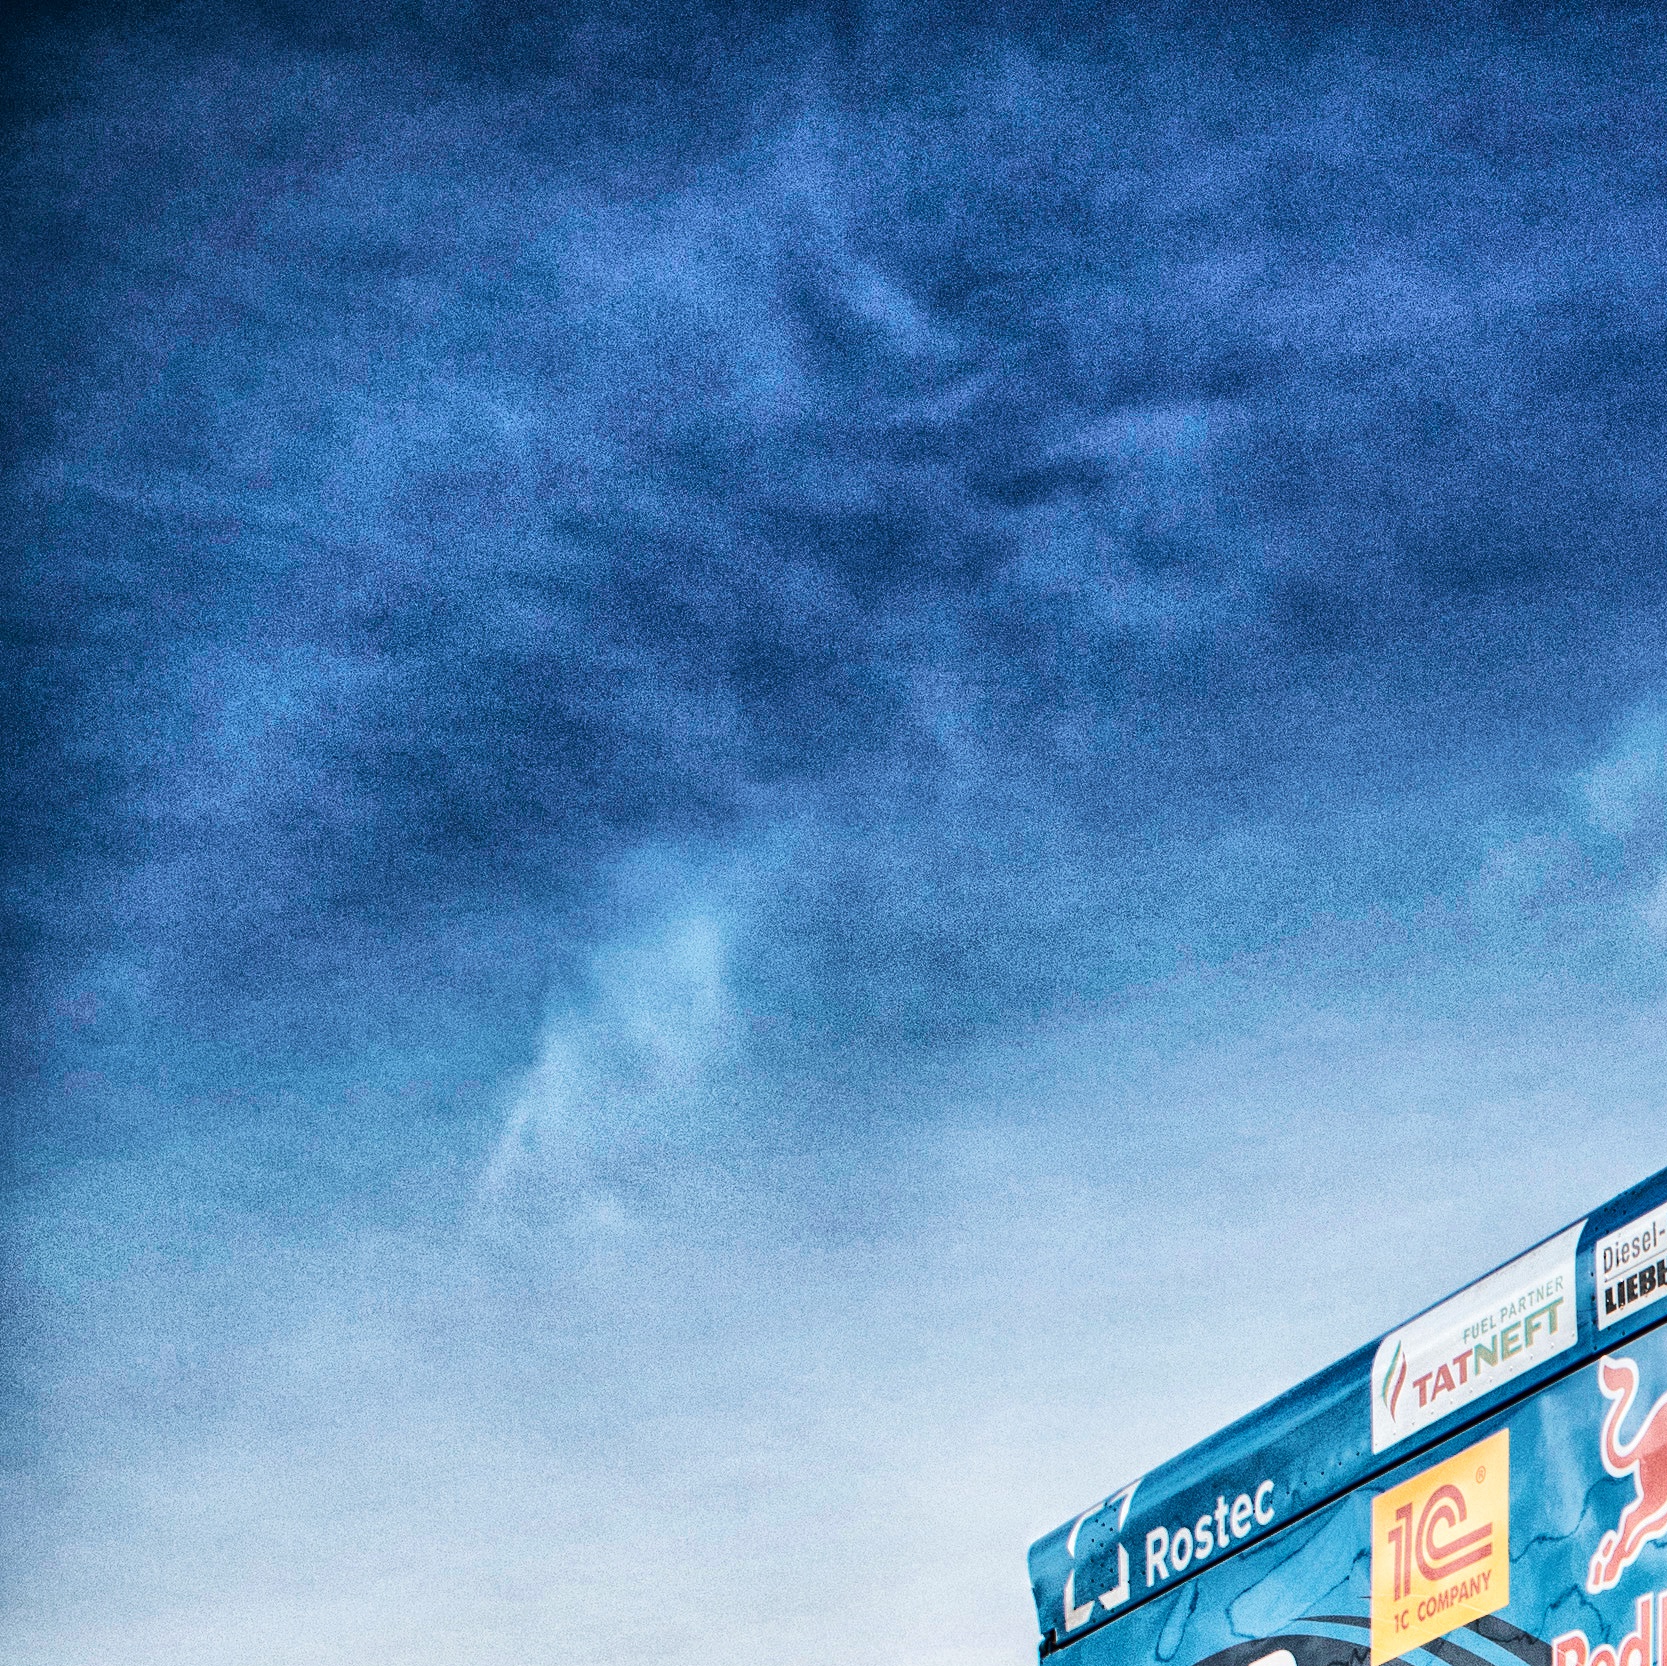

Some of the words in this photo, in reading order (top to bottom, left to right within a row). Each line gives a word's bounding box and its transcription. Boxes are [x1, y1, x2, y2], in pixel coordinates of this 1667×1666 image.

[1412, 1297, 1564, 1409] TATNEFT
[1462, 1316, 1497, 1344] FUEL
[1500, 1274, 1565, 1321] PARTNER
[1145, 1479, 1276, 1588] Rostec
[1394, 1610, 1411, 1634] 1C
[1417, 1570, 1492, 1622] COMPANY
